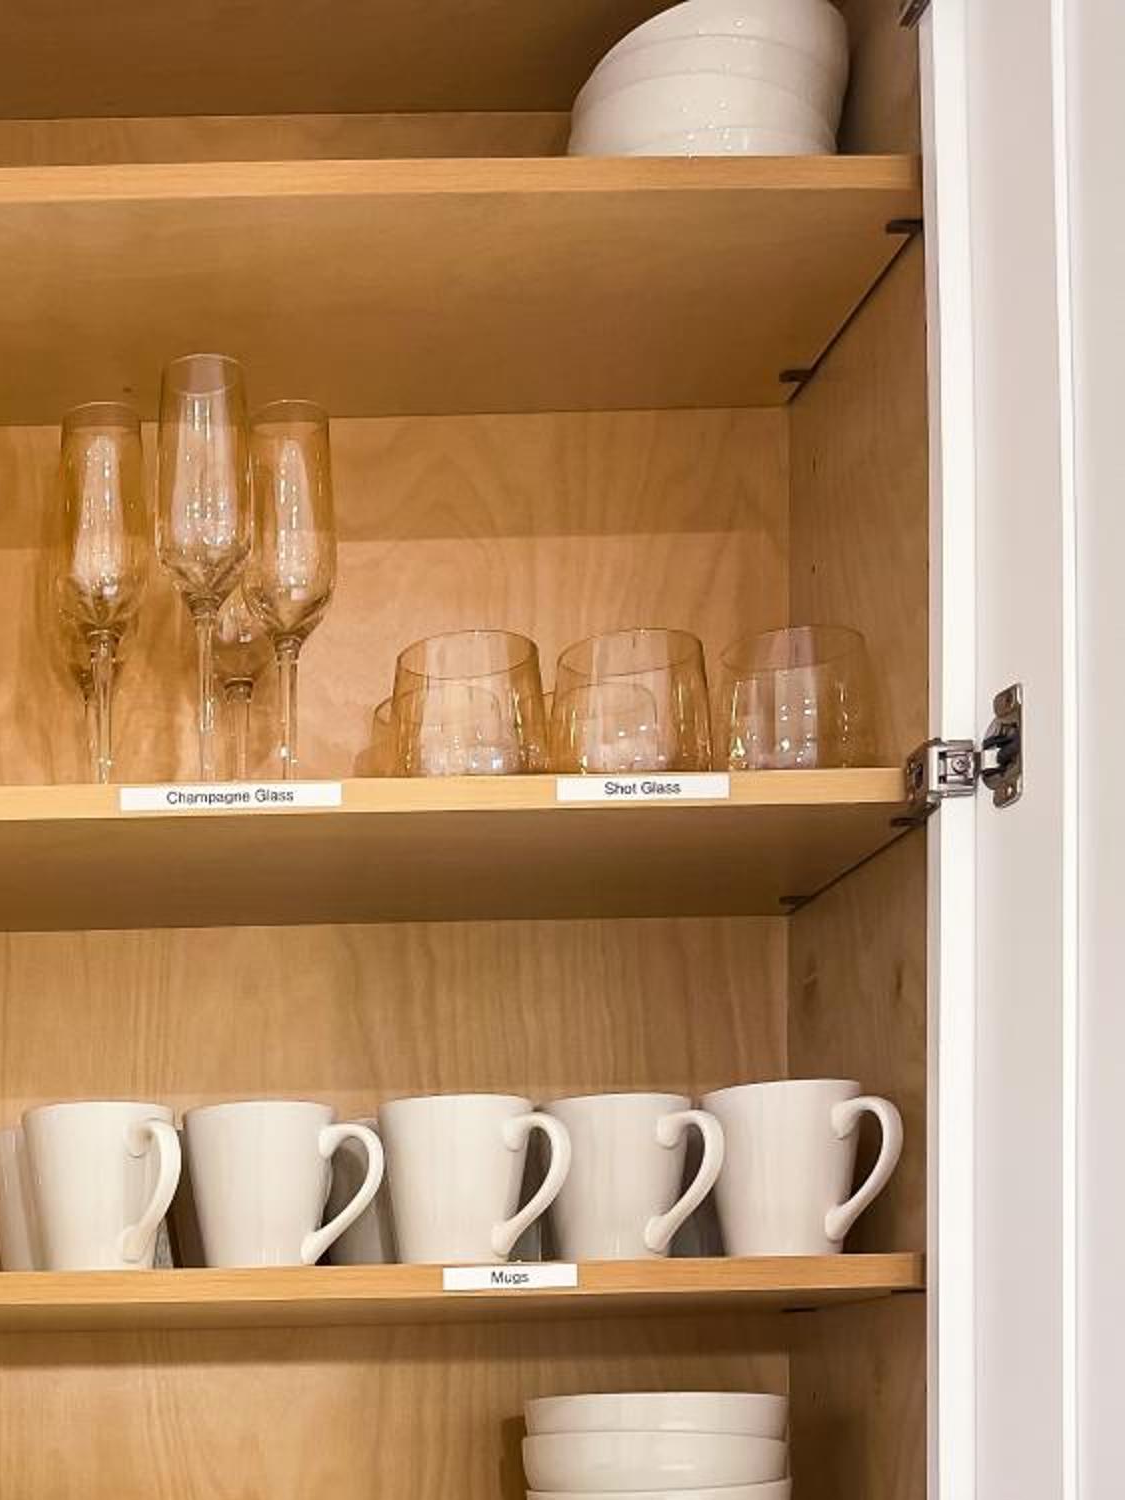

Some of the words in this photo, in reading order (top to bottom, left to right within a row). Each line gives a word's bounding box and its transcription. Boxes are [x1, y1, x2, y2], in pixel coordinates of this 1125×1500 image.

[604, 781, 637, 795] Shot
[640, 781, 682, 795] Glass
[166, 790, 250, 805] Champagne
[254, 788, 295, 803] Glass
[491, 1271, 530, 1285] Mugs
